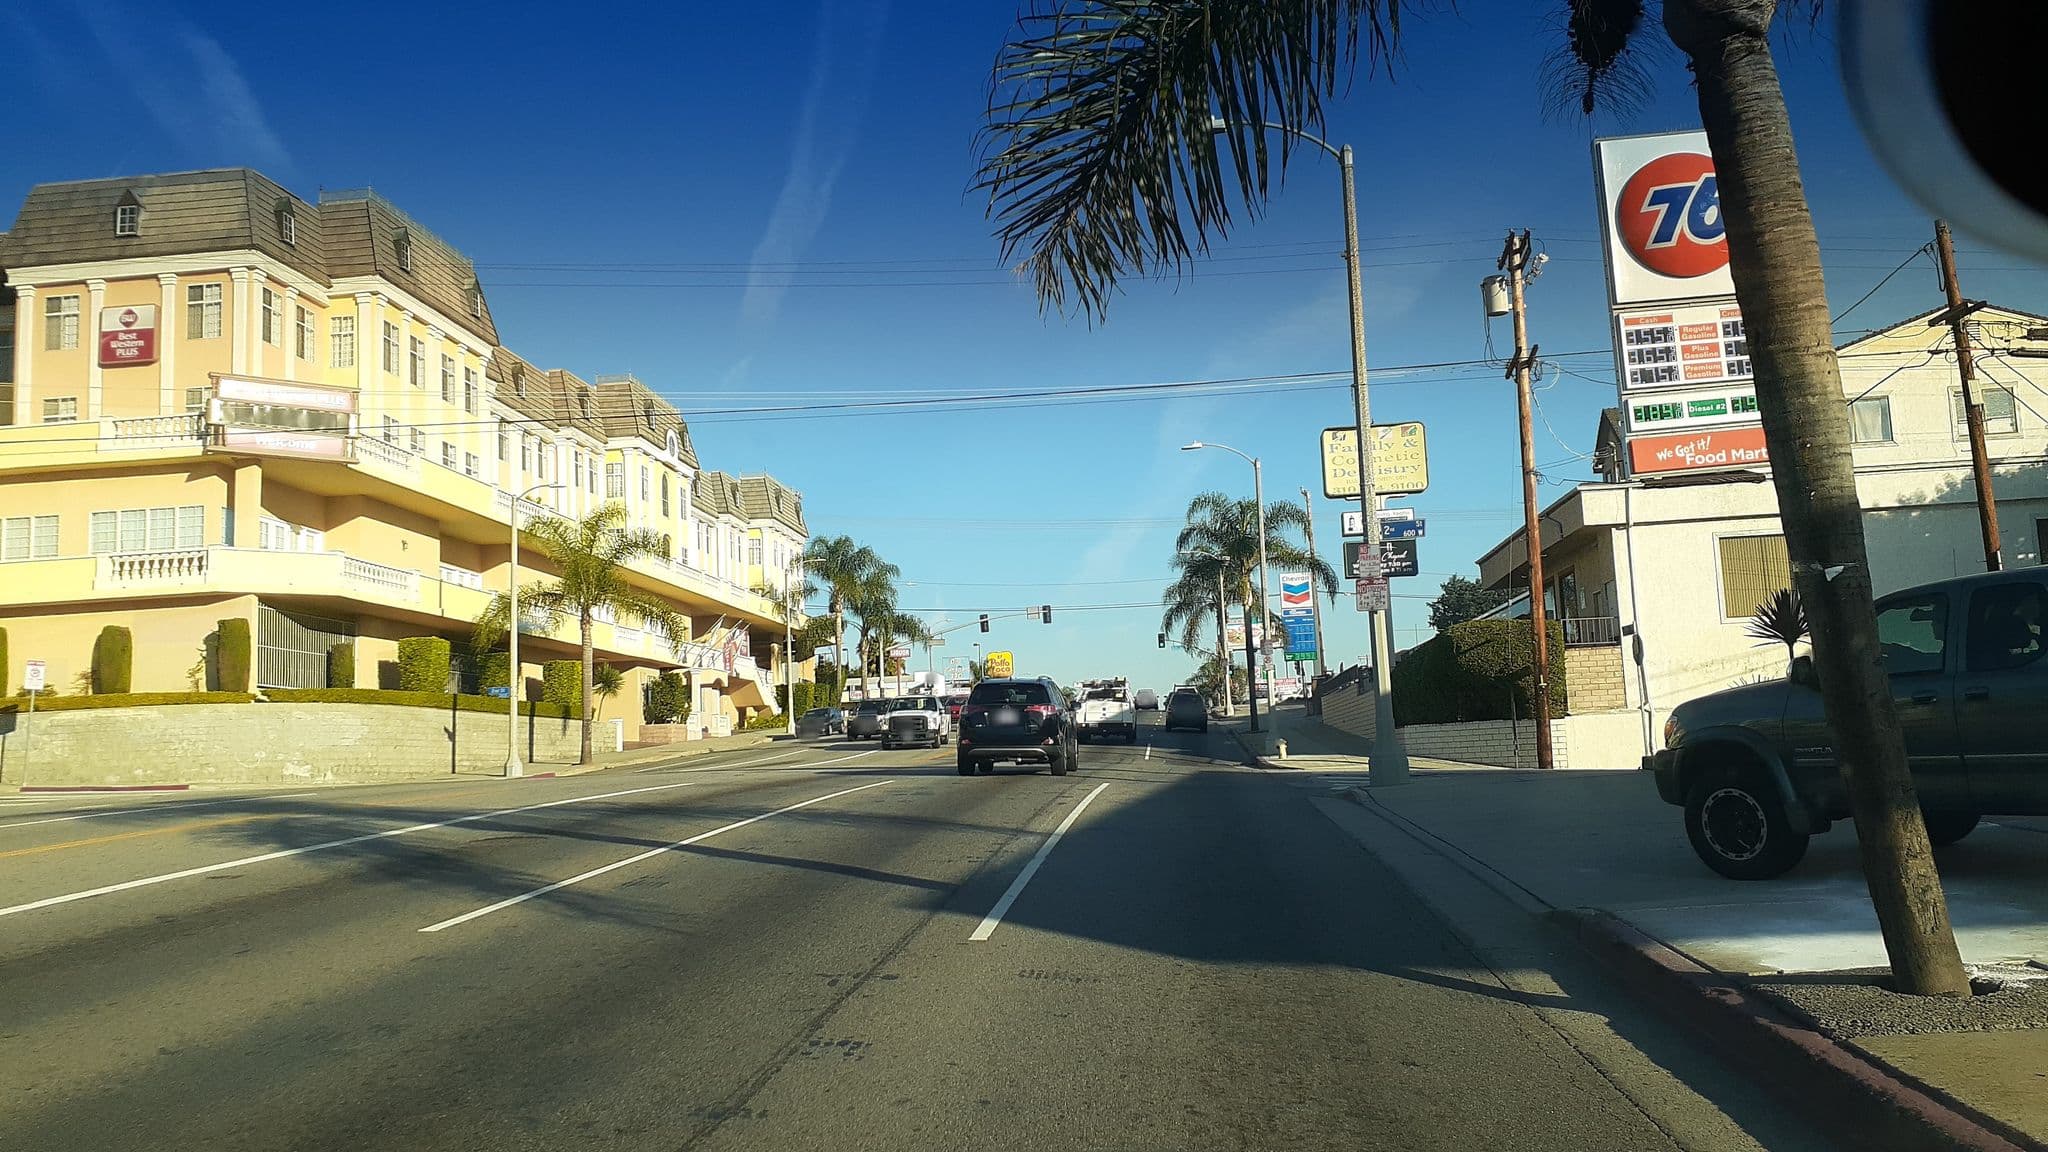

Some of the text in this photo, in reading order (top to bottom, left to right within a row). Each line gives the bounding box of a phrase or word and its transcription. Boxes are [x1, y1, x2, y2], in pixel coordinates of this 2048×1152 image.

[1640, 172, 1726, 250] 76
[1683, 326, 1714, 335] Regular
[118, 332, 137, 340] Best
[1682, 332, 1717, 340] Gasoline
[111, 340, 145, 348] Western
[116, 348, 139, 356] PLUS
[1684, 352, 1719, 360] Gasoline
[1685, 364, 1721, 372] Premium
[1687, 370, 1722, 379] Gasoline
[1688, 402, 1727, 413] Diesel #2
[1328, 438, 1419, 454] Faily &
[1656, 436, 1711, 462] We Got it!
[1685, 449, 1768, 465] Food Mart
[1332, 464, 1421, 478] Deistry
